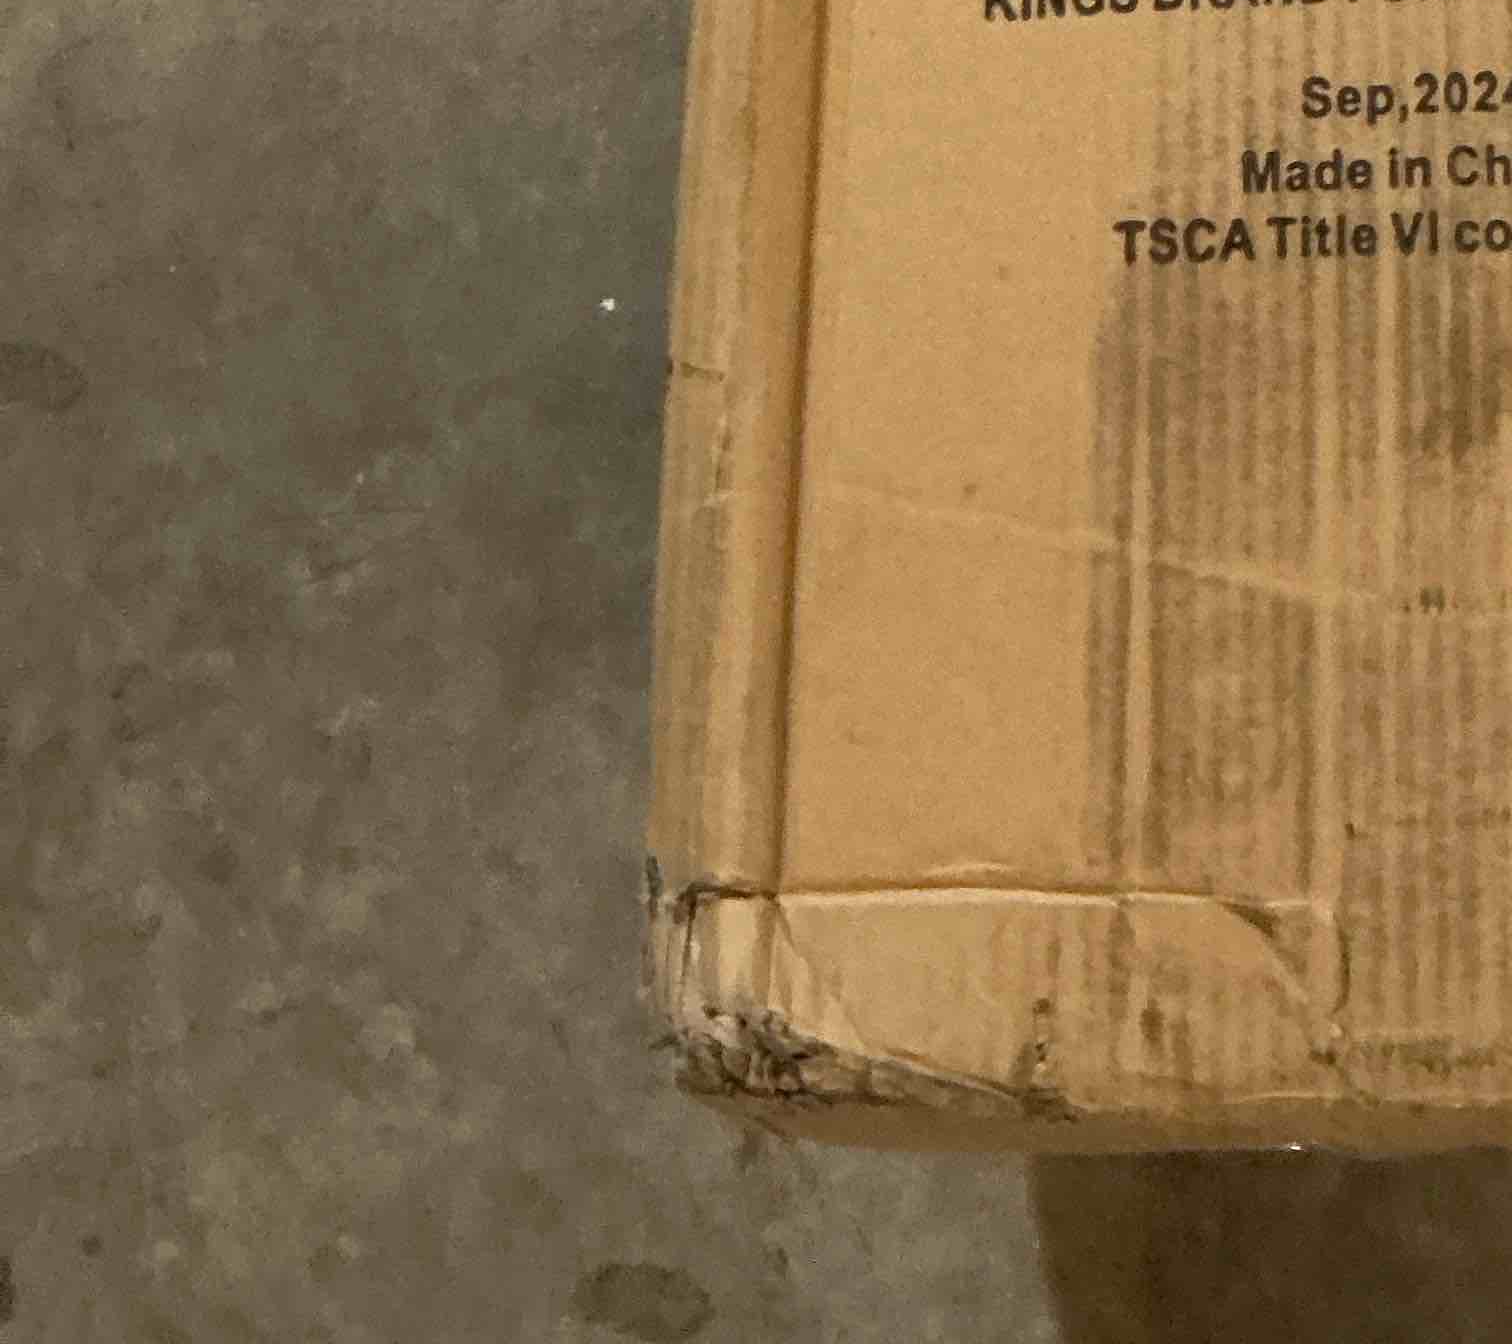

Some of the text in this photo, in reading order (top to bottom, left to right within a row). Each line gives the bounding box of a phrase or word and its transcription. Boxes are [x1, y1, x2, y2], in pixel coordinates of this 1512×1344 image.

[1241, 148, 1374, 195] Made
[1389, 147, 1433, 189] in
[1113, 212, 1256, 266] TSCA
[1267, 212, 1379, 259] Title
[1391, 211, 1440, 258] VI
